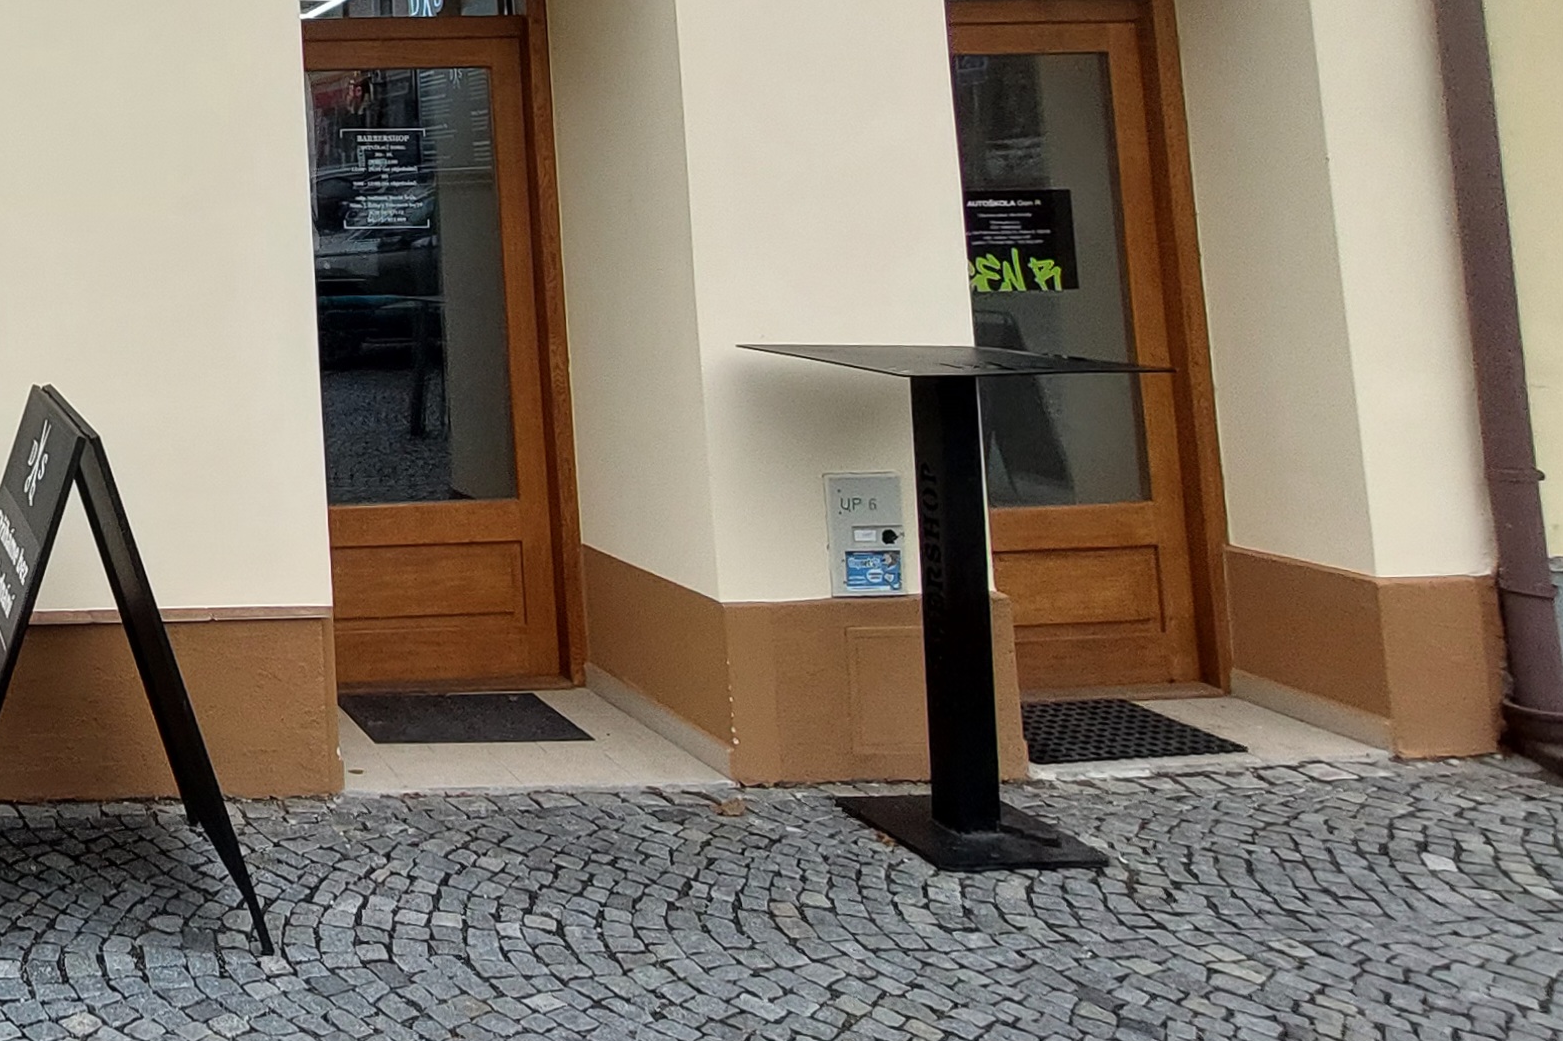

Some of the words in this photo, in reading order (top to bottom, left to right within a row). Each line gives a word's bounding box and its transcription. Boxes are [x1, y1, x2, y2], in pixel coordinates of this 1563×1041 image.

[356, 134, 410, 143] BARBERSHOP
[968, 246, 1027, 293] EN
[868, 497, 878, 511] 6
